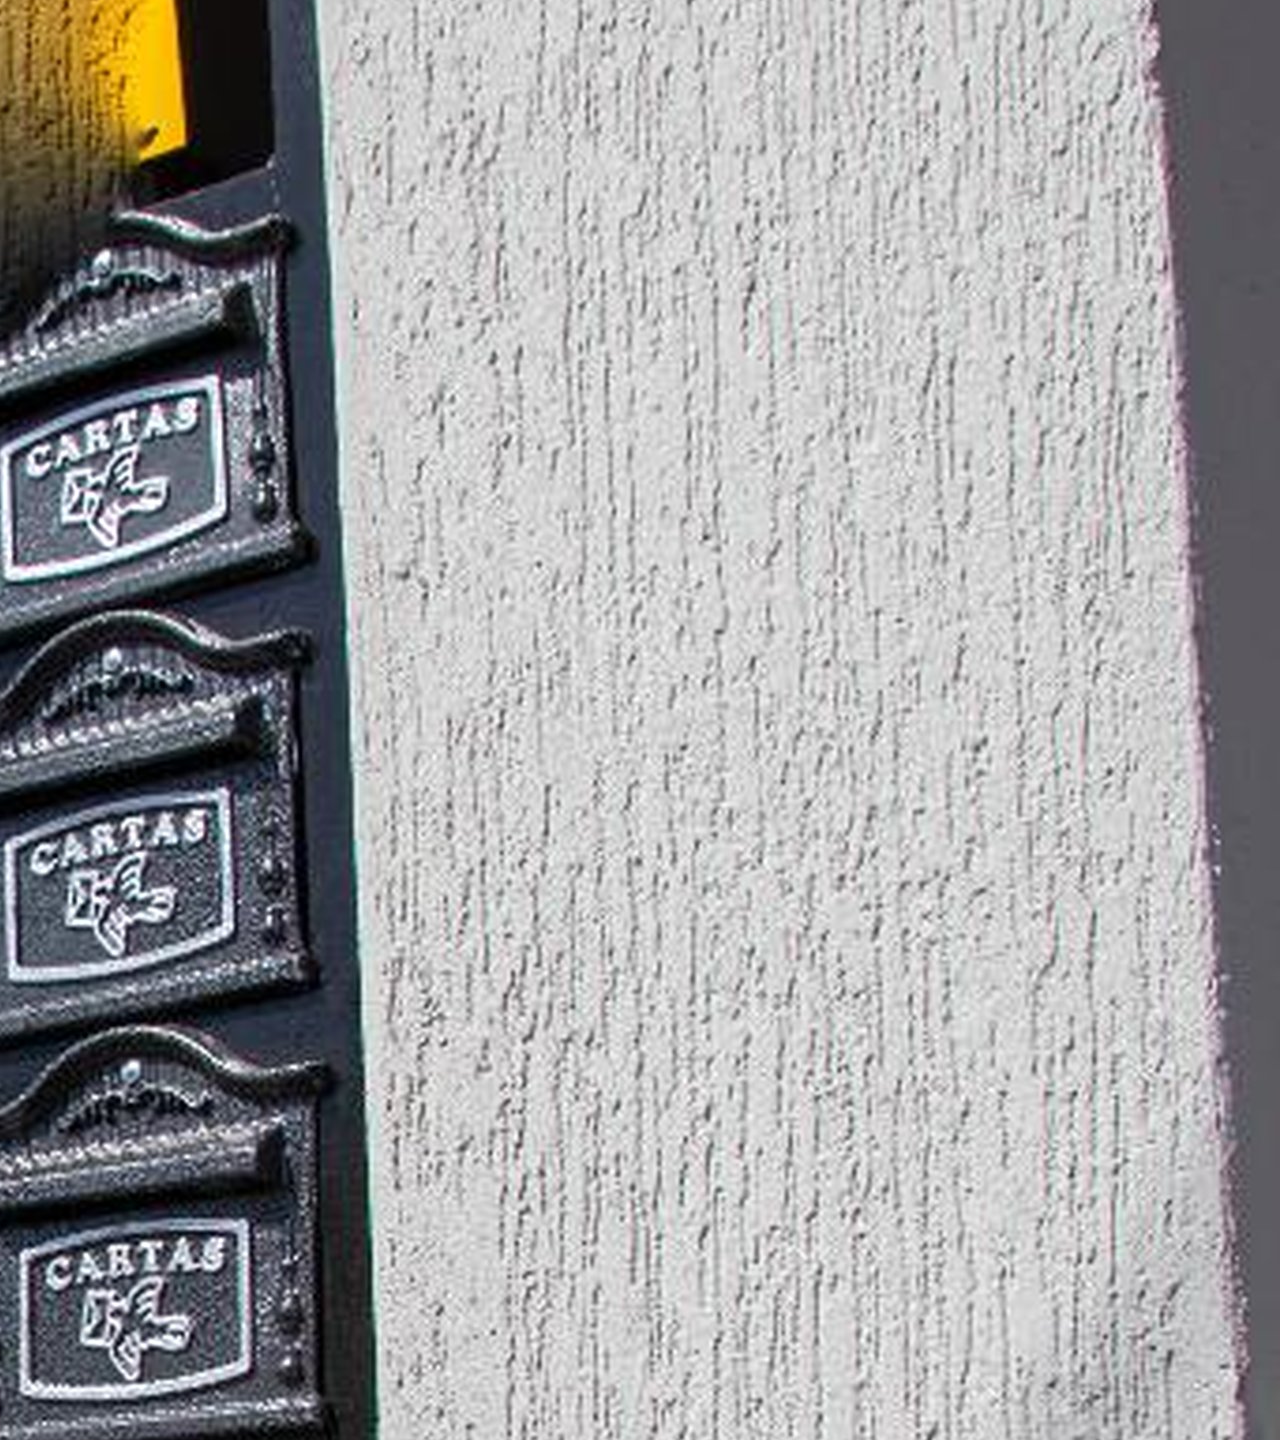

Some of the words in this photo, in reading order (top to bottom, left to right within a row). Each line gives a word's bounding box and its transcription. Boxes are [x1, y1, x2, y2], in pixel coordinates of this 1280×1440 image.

[25, 397, 200, 478] CARTAS
[29, 808, 208, 876] CARTAS
[46, 1237, 225, 1290] CARTAS
